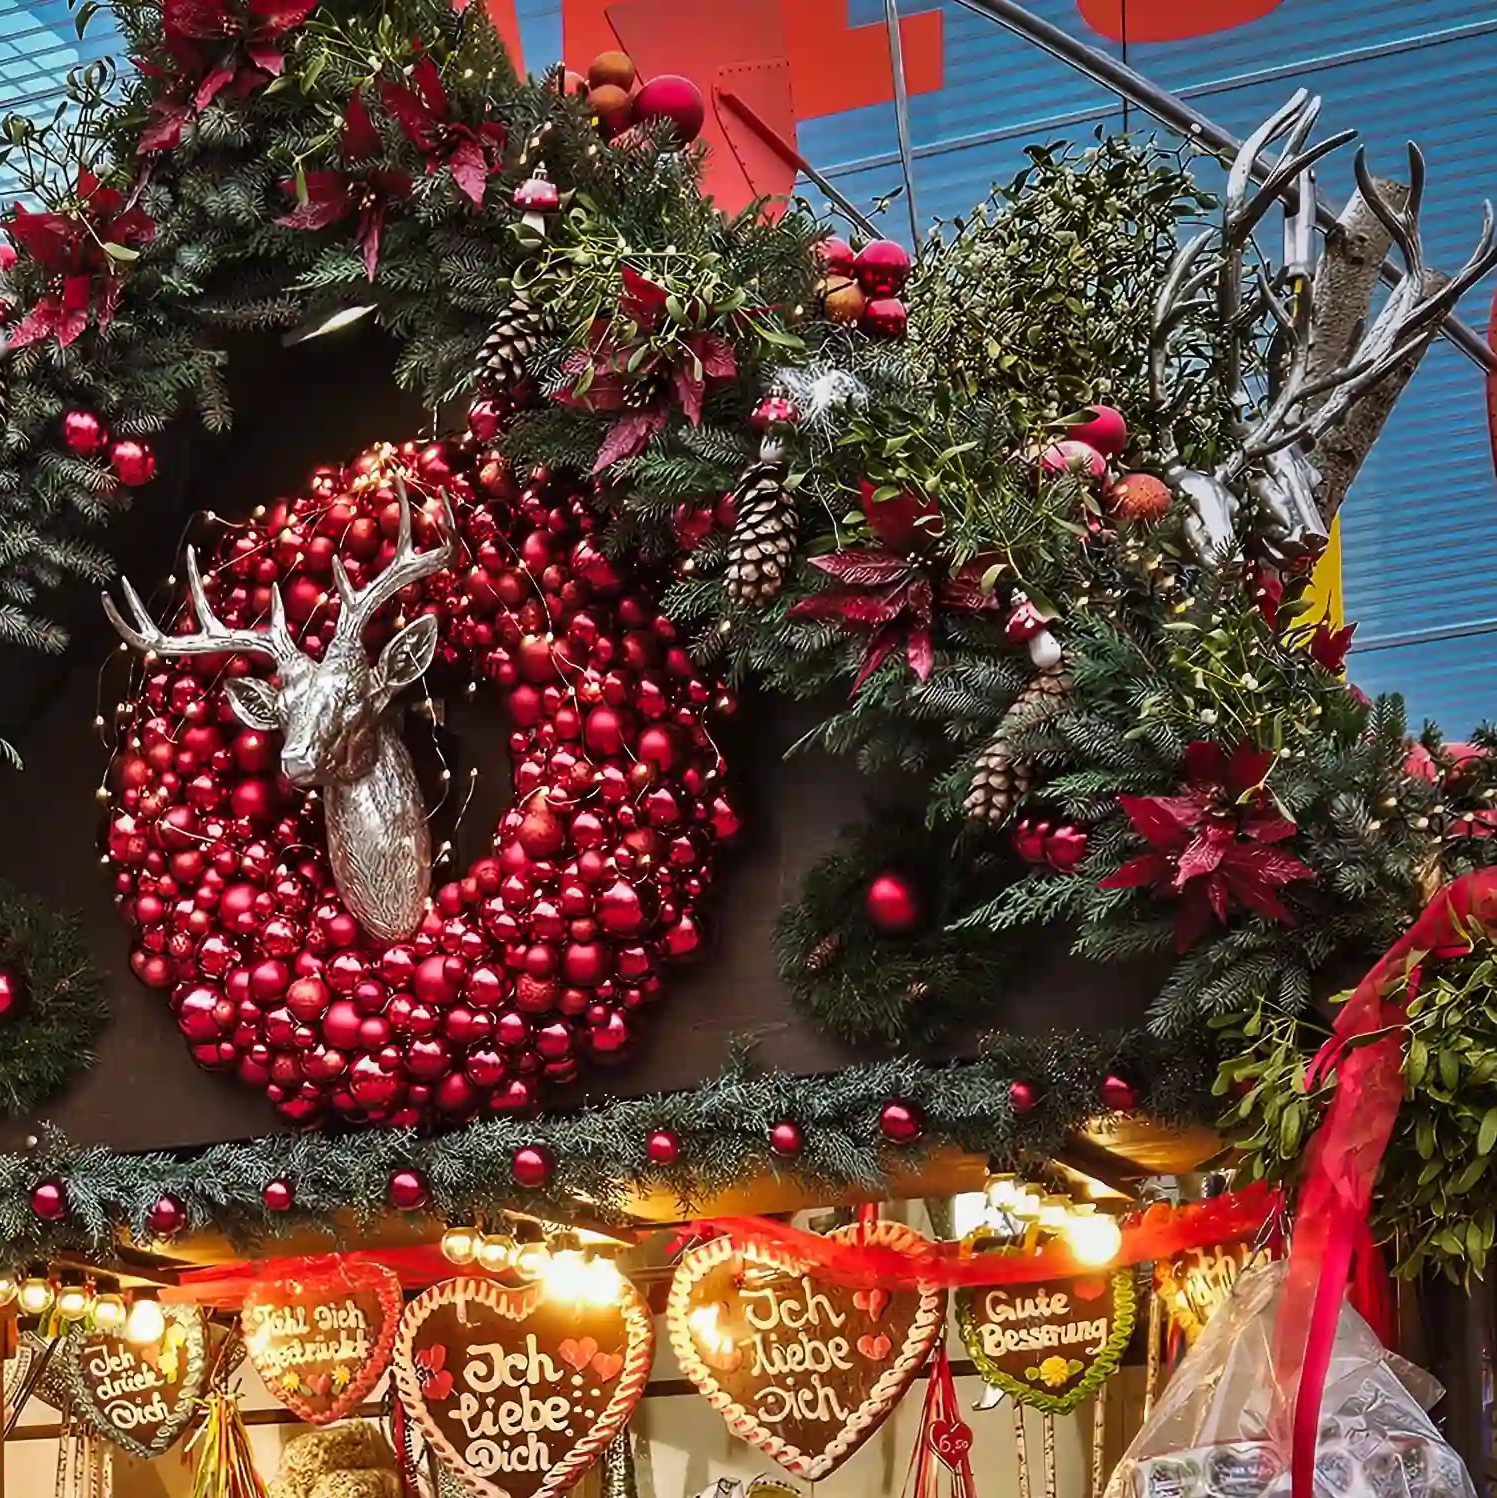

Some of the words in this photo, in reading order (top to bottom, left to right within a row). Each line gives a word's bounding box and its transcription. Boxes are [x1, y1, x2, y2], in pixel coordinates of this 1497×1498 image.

[318, 1298, 368, 1330] Dich
[742, 1277, 845, 1330] Ich
[985, 1289, 1071, 1320] Gute
[977, 1315, 1109, 1357] Besserung
[89, 1344, 134, 1378] Ich
[463, 1333, 565, 1393] Ich
[750, 1335, 854, 1377] liebe
[96, 1367, 161, 1404] drück
[753, 1383, 850, 1424] Dich
[106, 1398, 169, 1430] Dich
[449, 1389, 570, 1438] liebe
[466, 1437, 553, 1474] Dich
